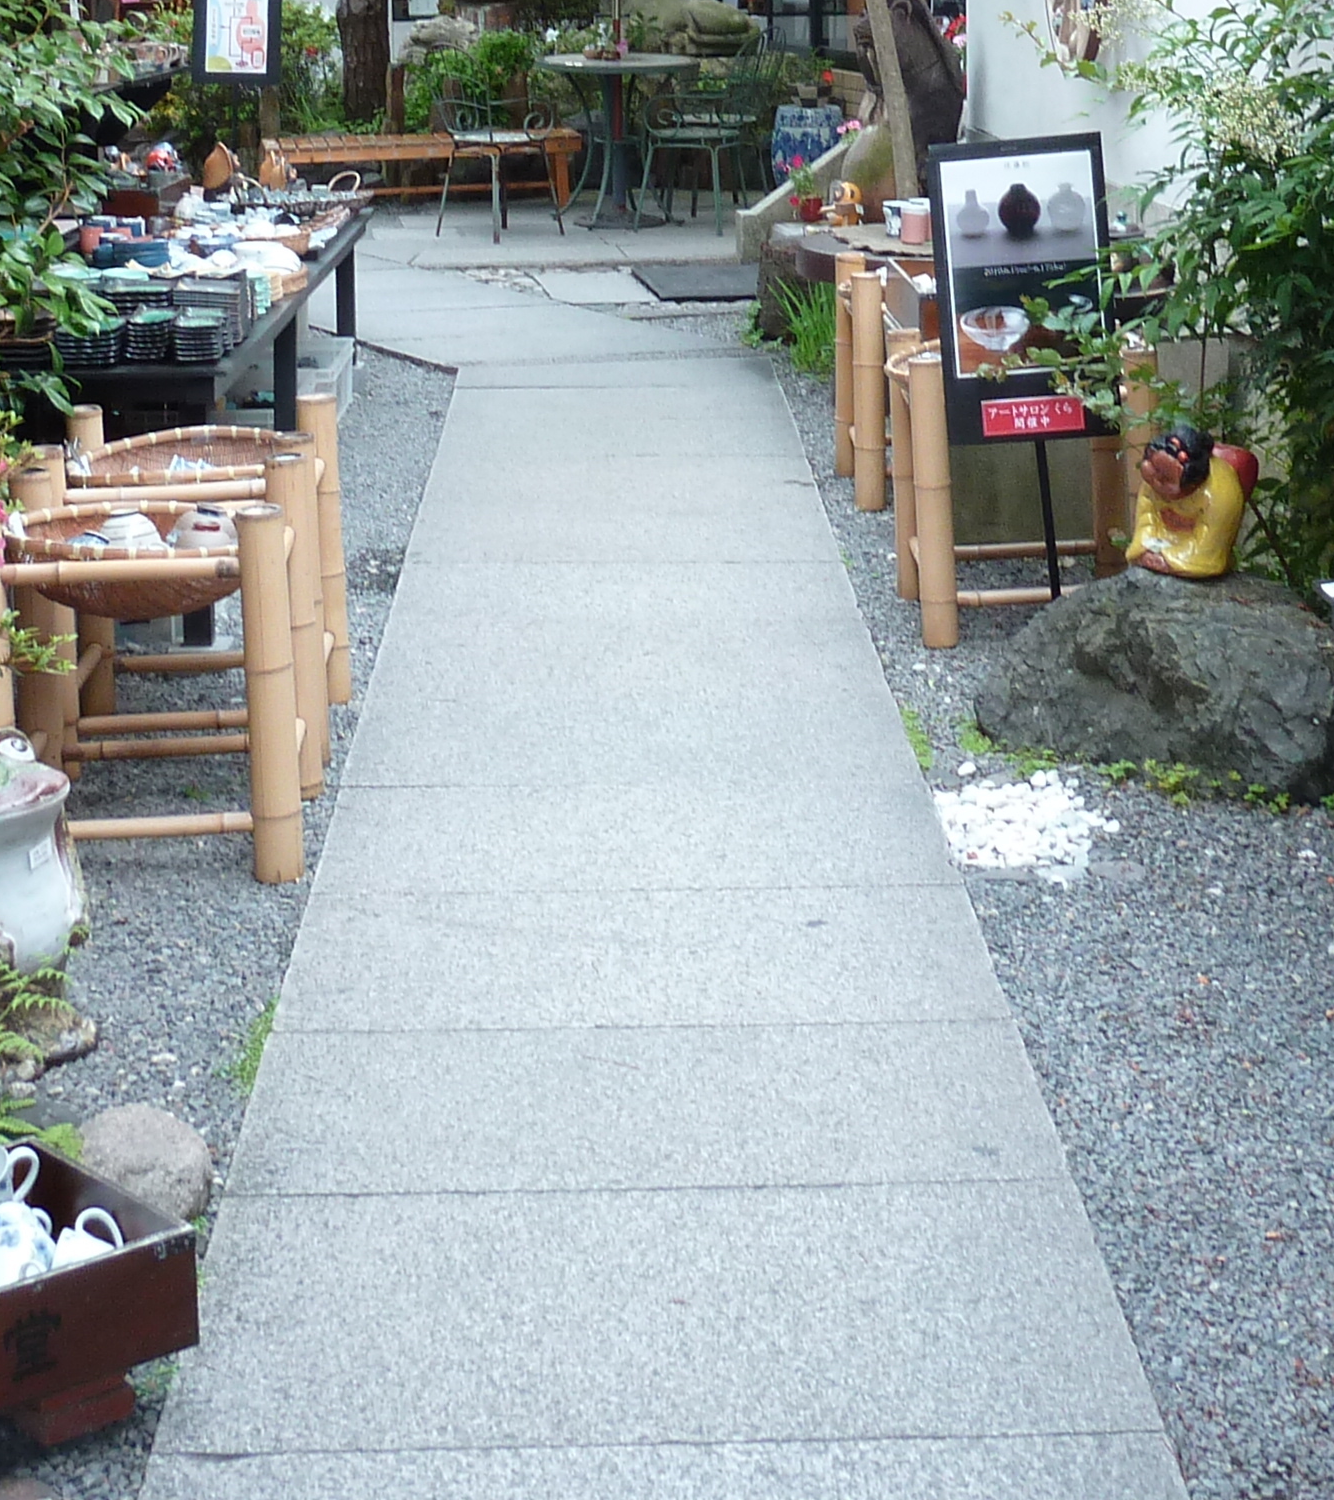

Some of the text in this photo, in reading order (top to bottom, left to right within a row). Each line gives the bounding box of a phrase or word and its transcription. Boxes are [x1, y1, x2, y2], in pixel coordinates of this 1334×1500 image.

[987, 403, 1050, 420] アートサロン
